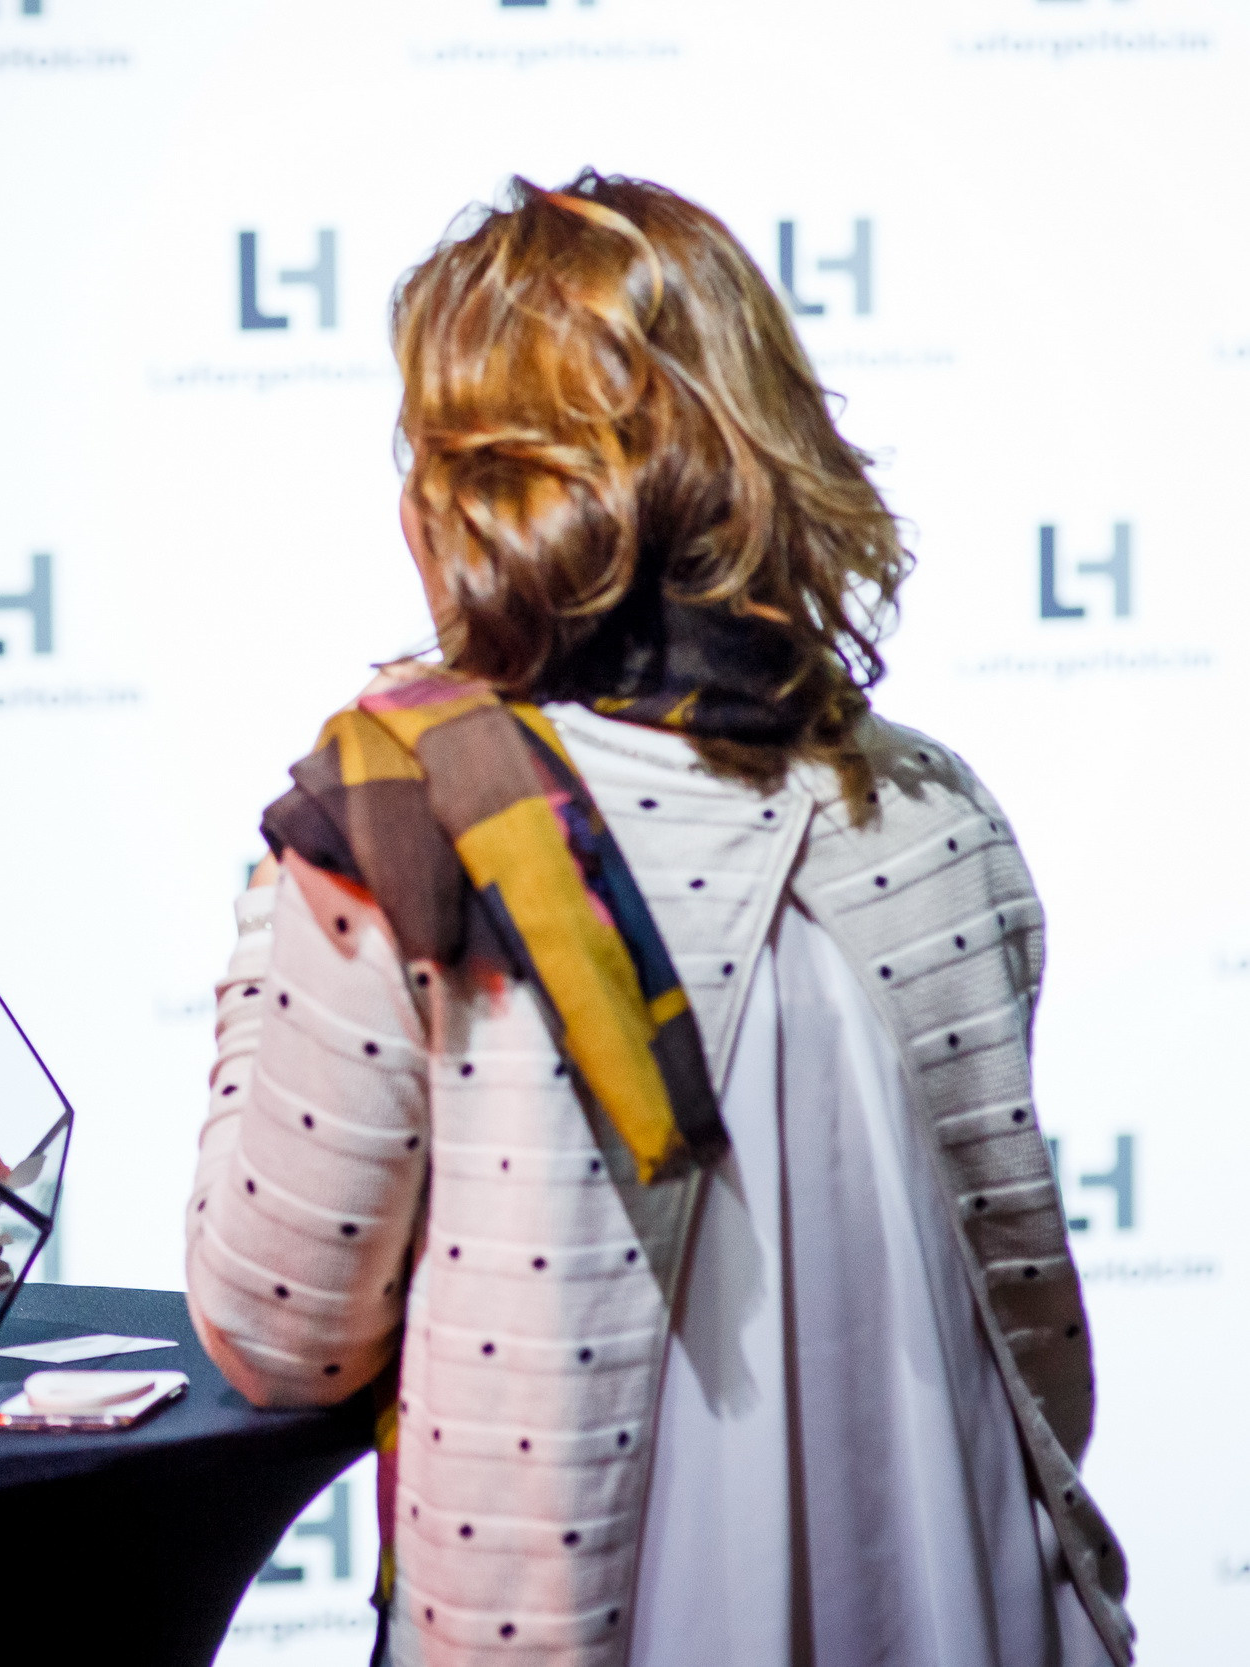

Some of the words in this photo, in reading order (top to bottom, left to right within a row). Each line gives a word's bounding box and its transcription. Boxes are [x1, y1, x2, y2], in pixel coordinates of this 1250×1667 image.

[239, 230, 337, 329] LH
[779, 219, 871, 315] LH
[1039, 523, 1131, 618] LH
